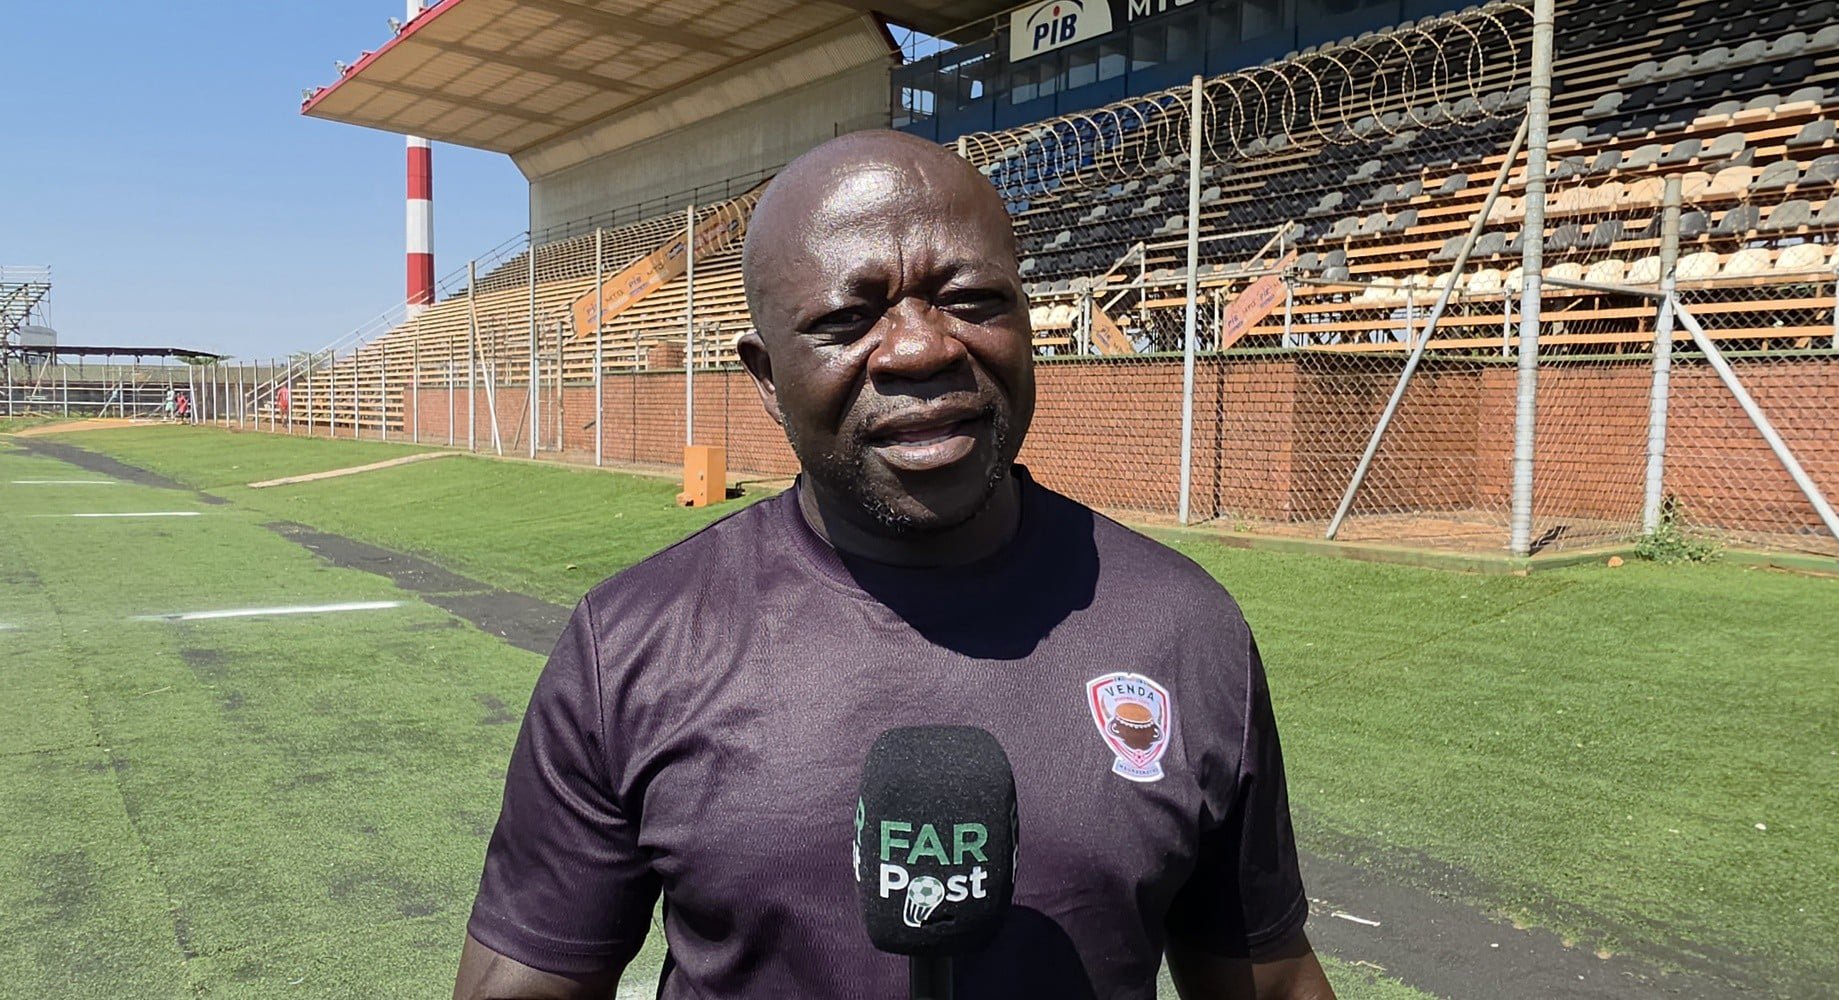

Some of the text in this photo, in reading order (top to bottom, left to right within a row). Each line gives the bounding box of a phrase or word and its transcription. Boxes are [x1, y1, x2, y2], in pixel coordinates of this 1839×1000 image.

[1033, 5, 1077, 51] PIB
[1104, 684, 1155, 701] VENDA
[880, 820, 988, 865] FAR
[879, 863, 988, 908] Post
